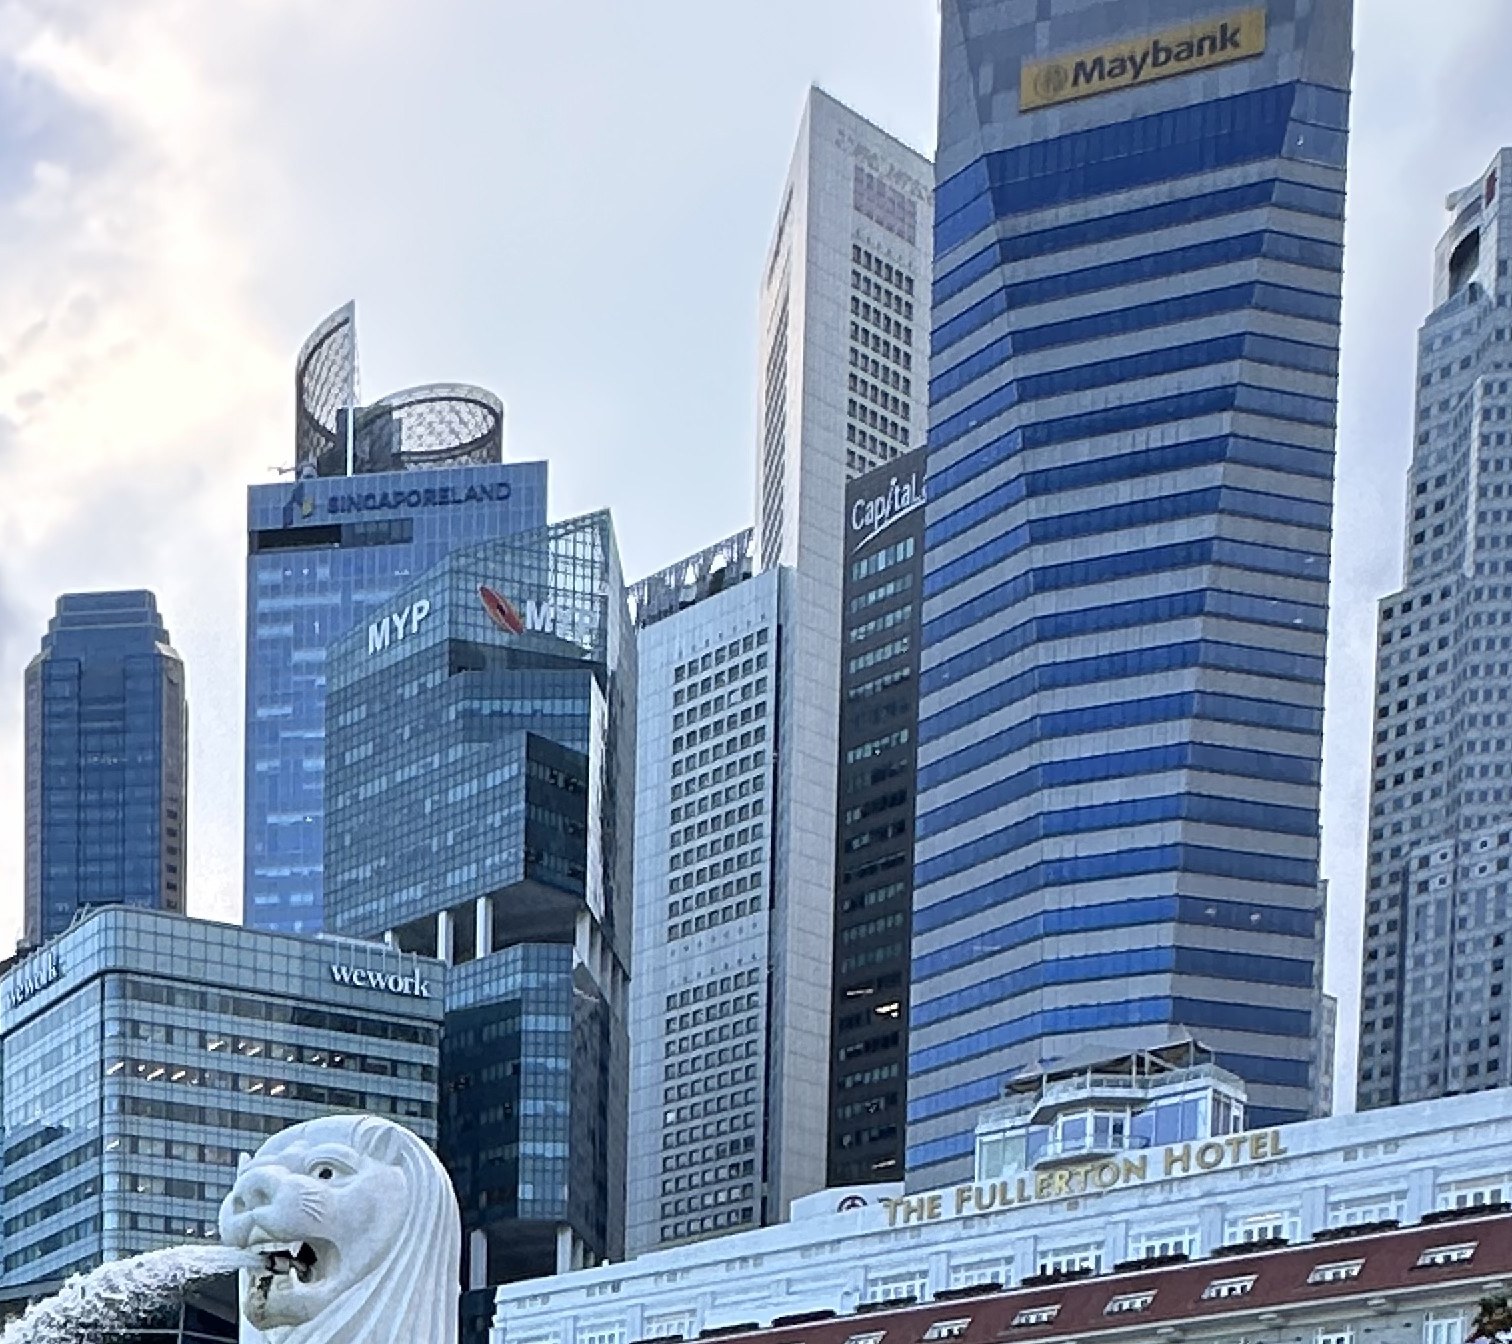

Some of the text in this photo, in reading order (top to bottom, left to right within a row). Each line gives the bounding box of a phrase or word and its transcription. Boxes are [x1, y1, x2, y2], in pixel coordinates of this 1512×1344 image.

[1071, 22, 1240, 88] Maybank
[368, 599, 430, 656] MYP
[331, 964, 433, 998] wework
[880, 1129, 1289, 1227] THE FULLERTON HOTEL
